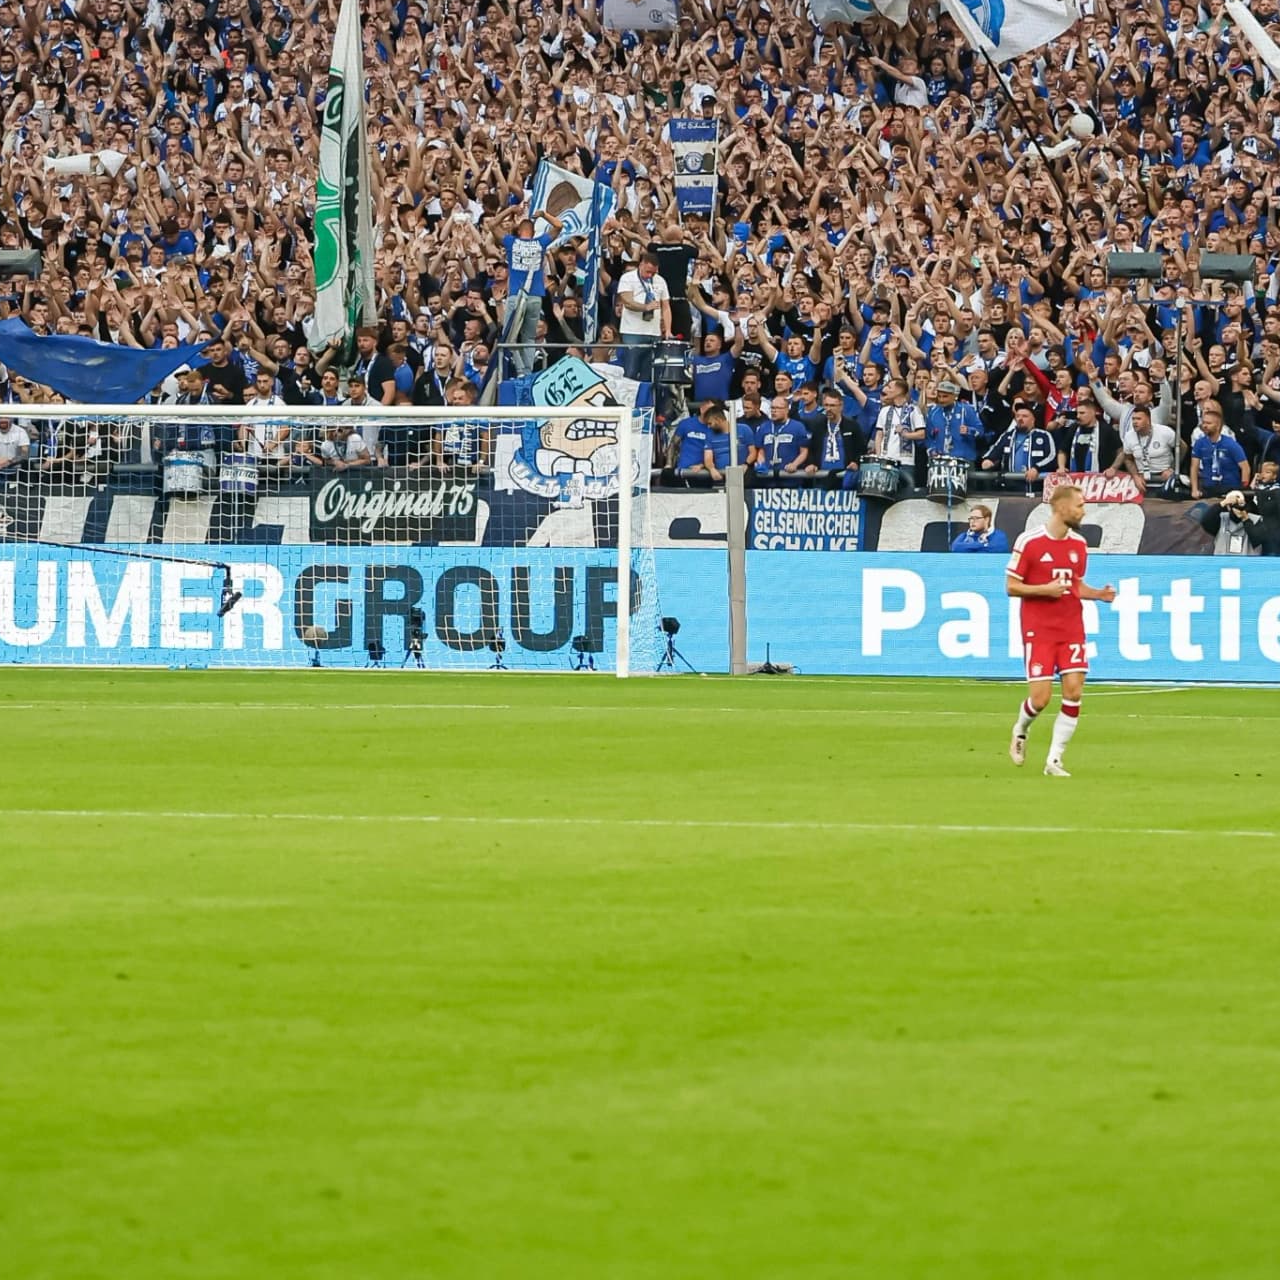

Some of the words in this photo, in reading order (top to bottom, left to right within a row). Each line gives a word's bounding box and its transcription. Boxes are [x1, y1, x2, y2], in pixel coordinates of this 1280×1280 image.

[317, 478, 442, 532] Original
[443, 485, 475, 515] 75
[754, 488, 860, 512] FUSSBALLCLUB
[754, 511, 860, 536] GELSENKIRCHEN
